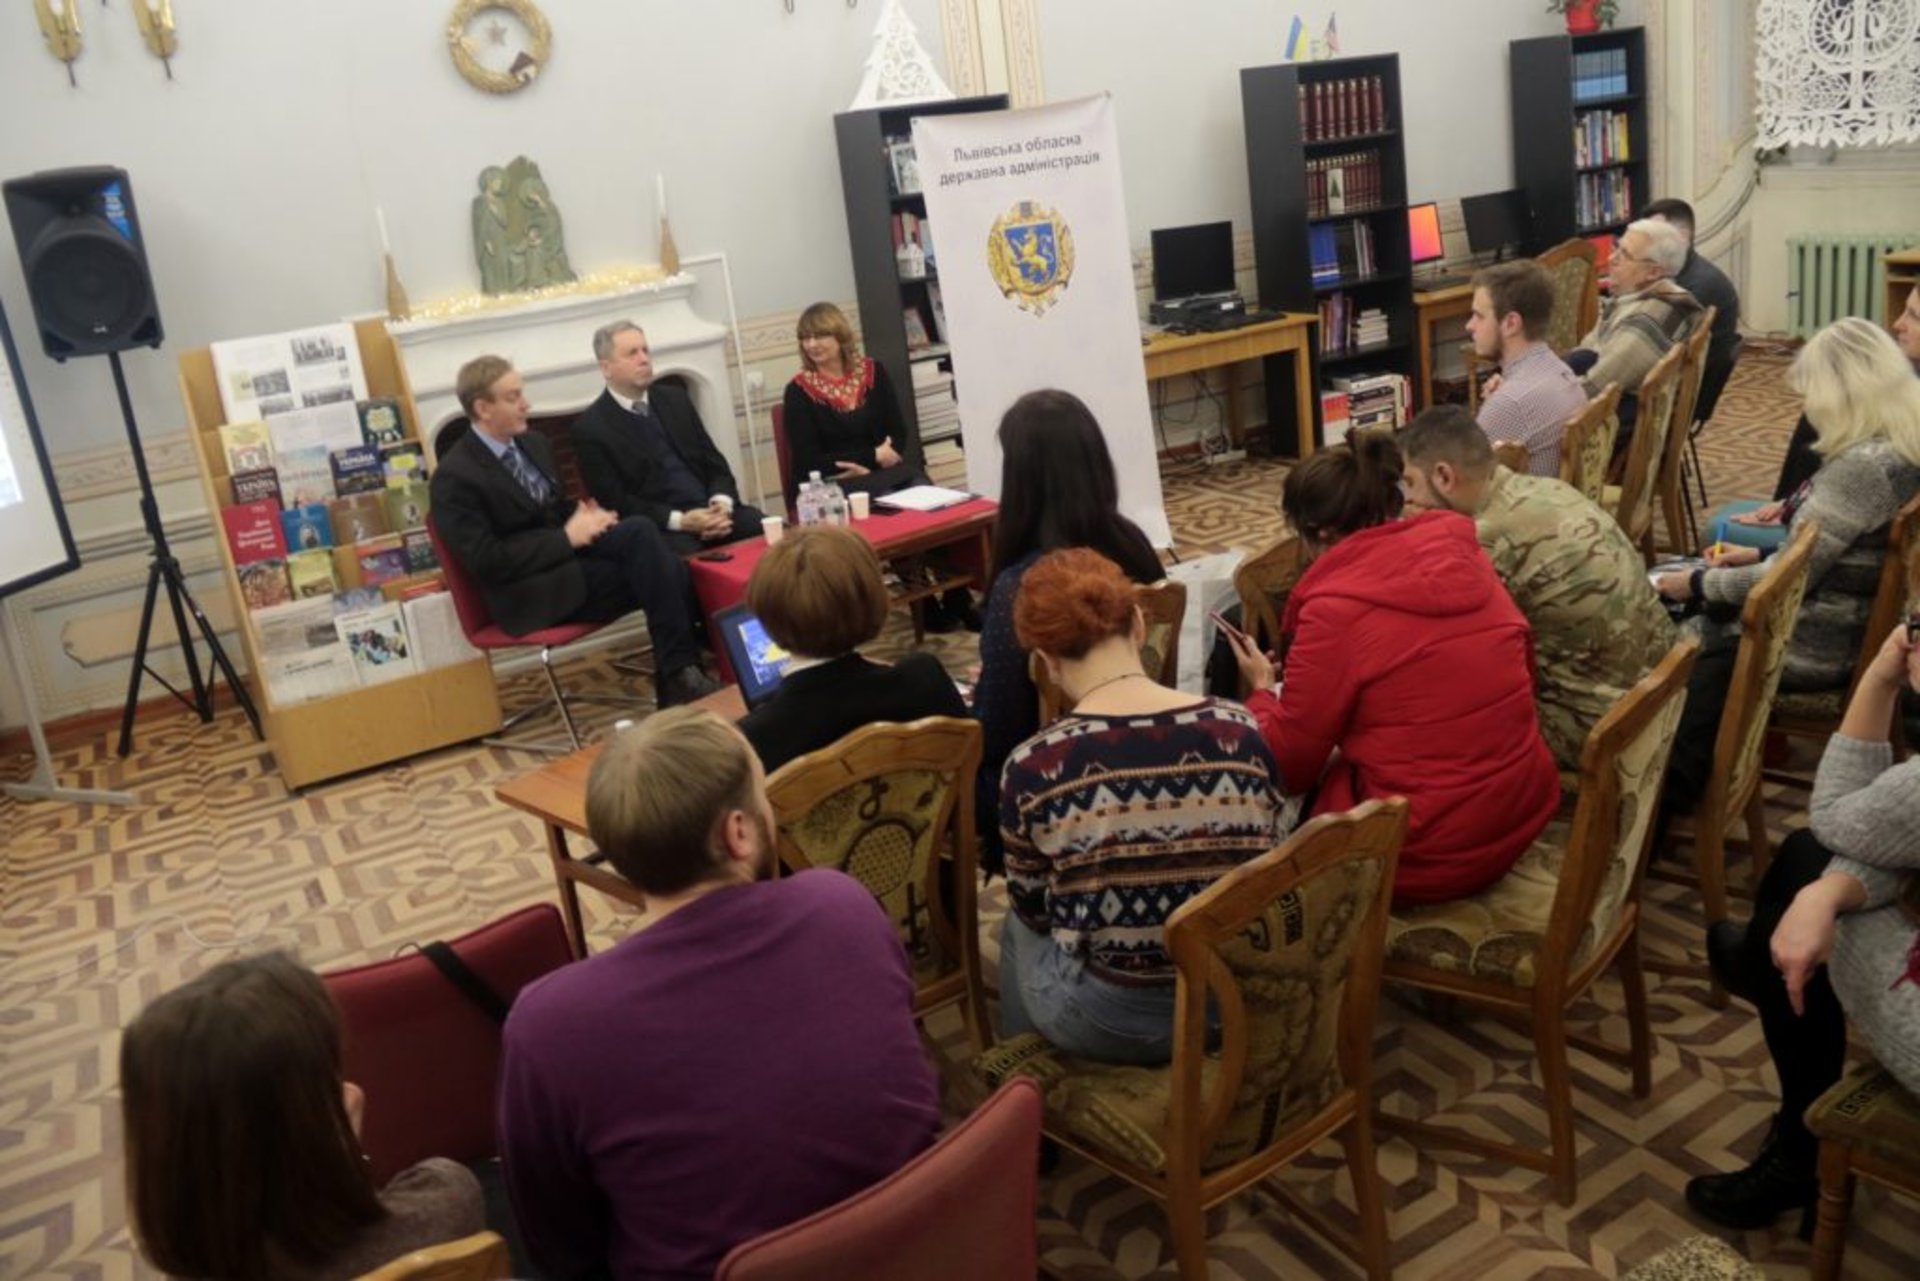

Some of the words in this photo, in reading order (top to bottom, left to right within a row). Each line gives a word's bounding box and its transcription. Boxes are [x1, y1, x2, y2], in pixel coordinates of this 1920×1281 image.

[954, 143, 1023, 162] Львівська
[1025, 134, 1082, 152] обласна
[939, 165, 1006, 186] державна
[1009, 152, 1101, 175] адміністрація
